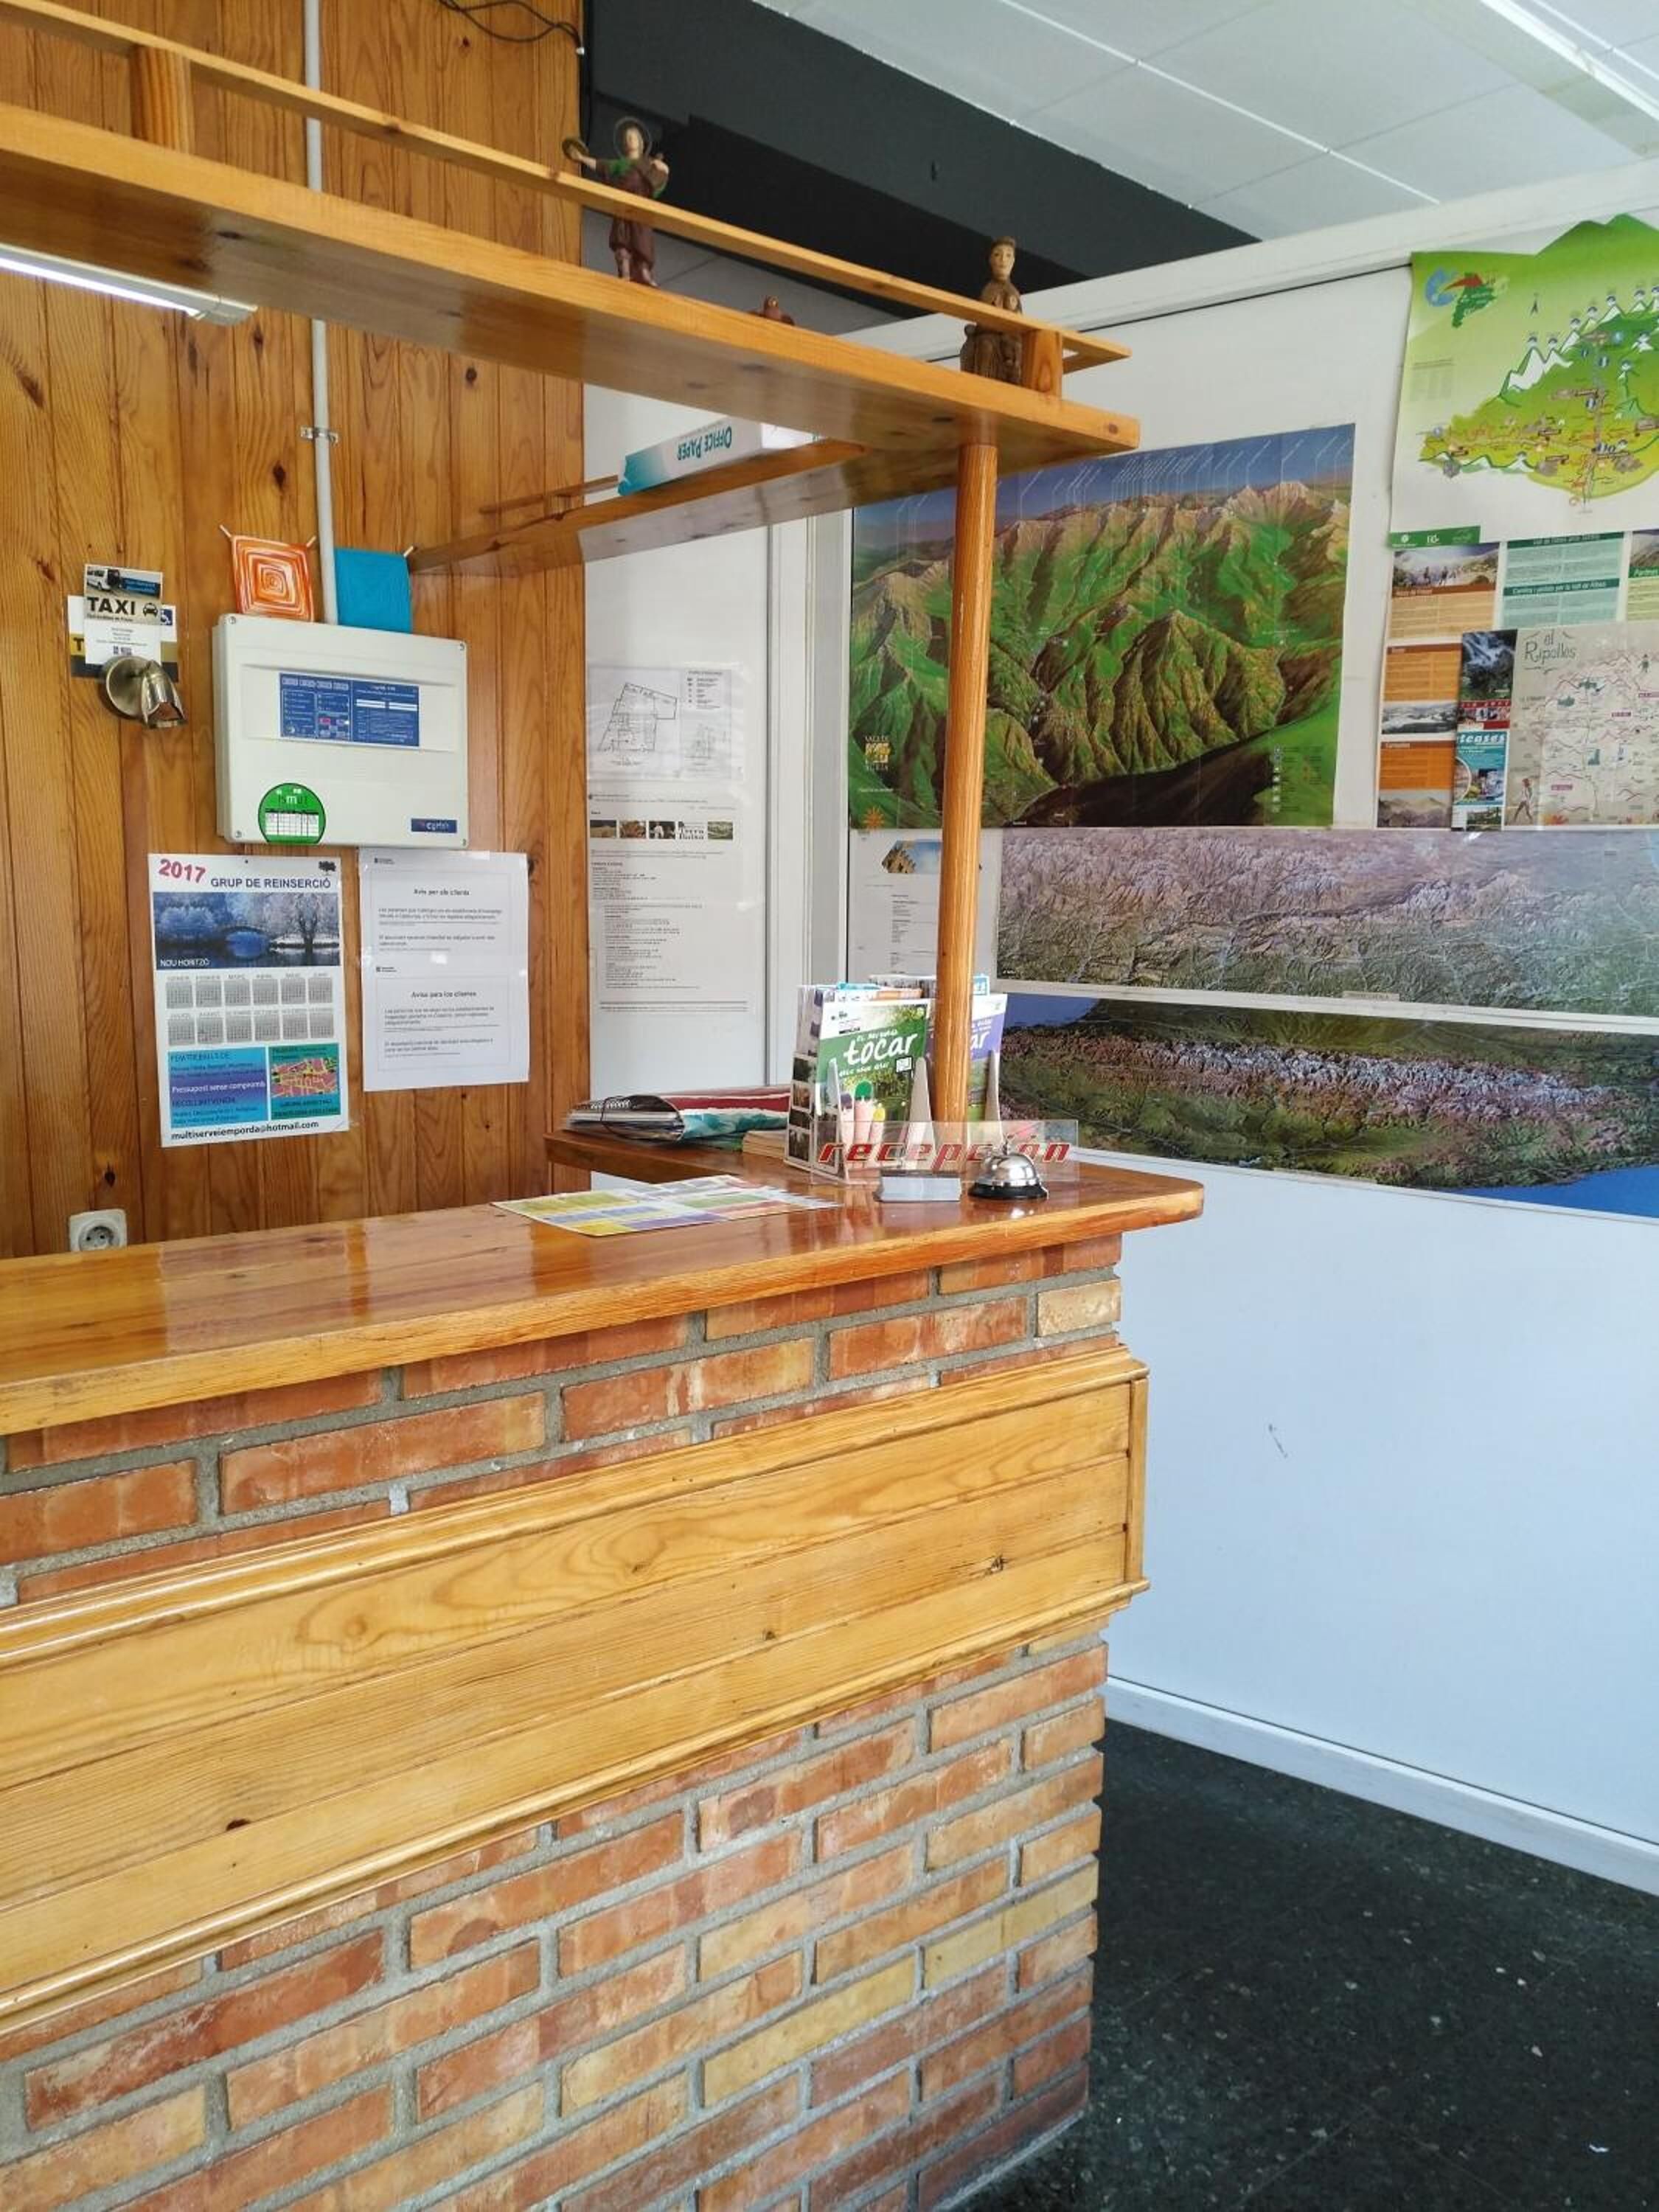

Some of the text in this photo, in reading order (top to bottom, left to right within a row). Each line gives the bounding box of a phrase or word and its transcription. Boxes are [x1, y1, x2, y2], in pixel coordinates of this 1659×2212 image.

[678, 426, 732, 460] OFFICE PAPER
[86, 596, 136, 616] TAXI
[158, 858, 206, 884] 2017
[211, 877, 331, 889] GRUP DE REINSERCIÓ
[844, 1033, 917, 1065] tocar
